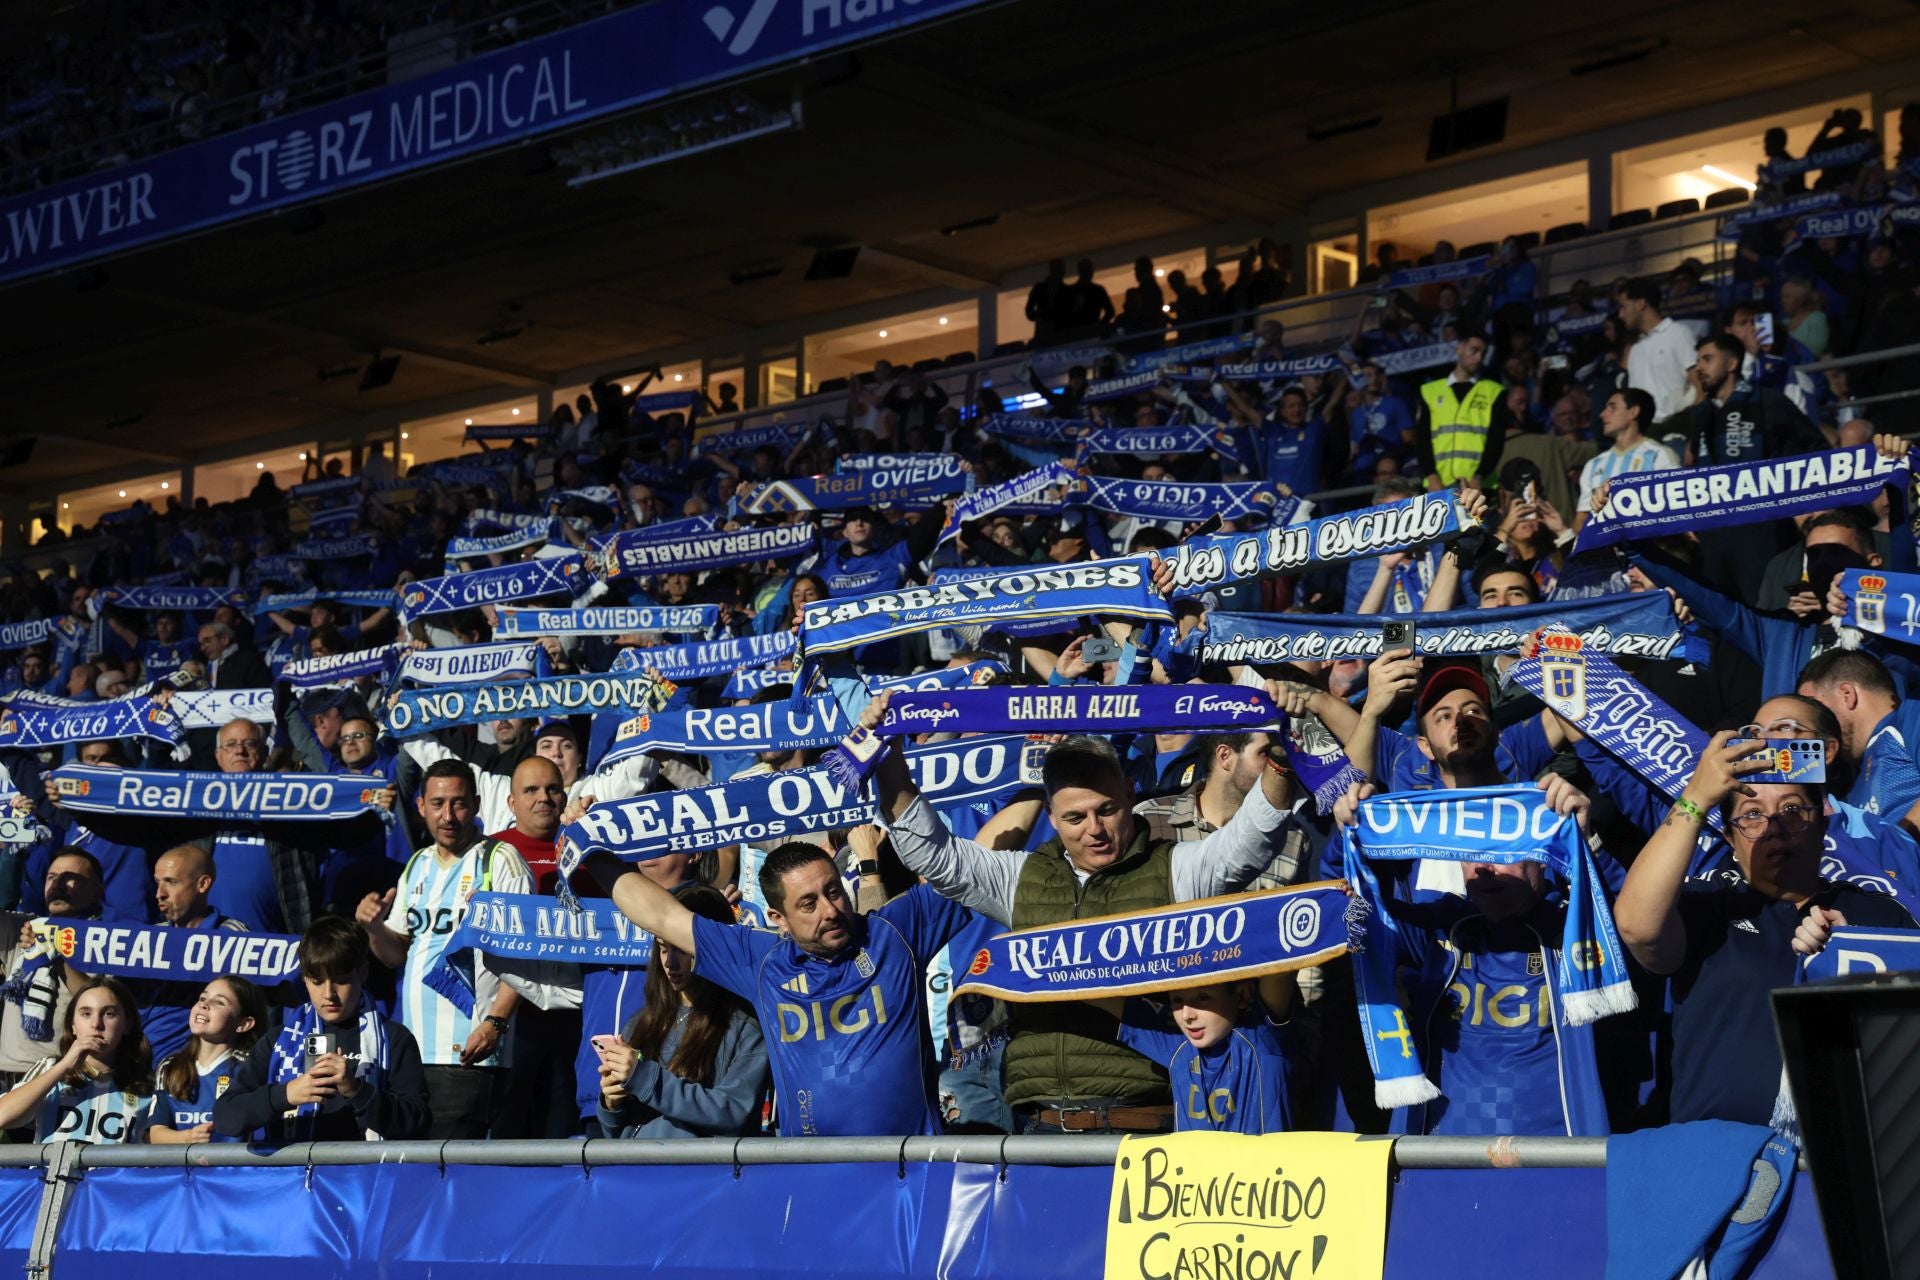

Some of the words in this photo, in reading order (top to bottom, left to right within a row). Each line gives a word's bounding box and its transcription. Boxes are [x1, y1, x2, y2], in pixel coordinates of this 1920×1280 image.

[388, 49, 587, 162] MEDICAL
[0, 172, 157, 264] WIVER
[1806, 212, 1849, 234] Real
[1263, 355, 1333, 374] OVIEDO
[1726, 411, 1741, 457] OVIEDO
[1741, 421, 1755, 448] Real
[815, 475, 863, 495] Real
[871, 460, 961, 489] OVIEDO
[841, 455, 875, 469] eal
[870, 488, 909, 503] 1926
[1778, 491, 1827, 506] DEFENDEMOS
[1827, 485, 1862, 497] NUESTRO
[1234, 539, 1259, 577] a
[1268, 528, 1310, 567] tu
[1318, 494, 1447, 558] escudo
[804, 565, 1142, 631] GARBAYONES
[1, 617, 53, 645] OVIEDO
[539, 610, 577, 629] Real
[583, 608, 654, 628] OVIEDO
[660, 606, 703, 628] 1926
[640, 648, 695, 670] PEÑA
[698, 643, 741, 665] AZUL
[1292, 631, 1322, 657] de
[1452, 626, 1531, 656] infie
[1611, 630, 1682, 660] azul
[662, 668, 696, 678] Unidos
[700, 665, 716, 677] por
[390, 703, 412, 731] O
[420, 691, 465, 723] NO
[1007, 695, 1077, 720] GARRA
[1086, 694, 1140, 719] AZUL
[1174, 694, 1195, 715] El
[685, 703, 772, 741] Real
[1586, 678, 1693, 775] Peña
[779, 740, 816, 749] FUNDADO
[819, 738, 832, 746] EN
[118, 777, 193, 809] Real
[202, 781, 335, 811] OVIEDO
[577, 787, 750, 845] REAL
[1363, 797, 1567, 841] OVIEDO
[668, 819, 786, 851] HEMOS
[1391, 848, 1419, 857] SOMOS,
[1421, 848, 1450, 858] FUIMOS
[535, 907, 601, 941] AZUL
[1595, 894, 1613, 926] FUIMOS
[1609, 934, 1627, 976] SEREMOS
[83, 926, 172, 970] REAL
[183, 932, 301, 977] OVIEDO
[480, 934, 531, 951] Unidos
[538, 943, 564, 956] por
[570, 944, 586, 955] un
[1008, 929, 1091, 979] REAL
[1098, 906, 1246, 962] OVIEDO
[1048, 969, 1068, 983] 100
[1068, 965, 1097, 980] AÑOS
[1098, 966, 1111, 978] DE
[1112, 963, 1147, 978] GARRA
[1176, 954, 1203, 970] 1926
[1211, 943, 1242, 962] 2026
[776, 985, 887, 1043] DIGI
[56, 1105, 137, 1141] DIGI
